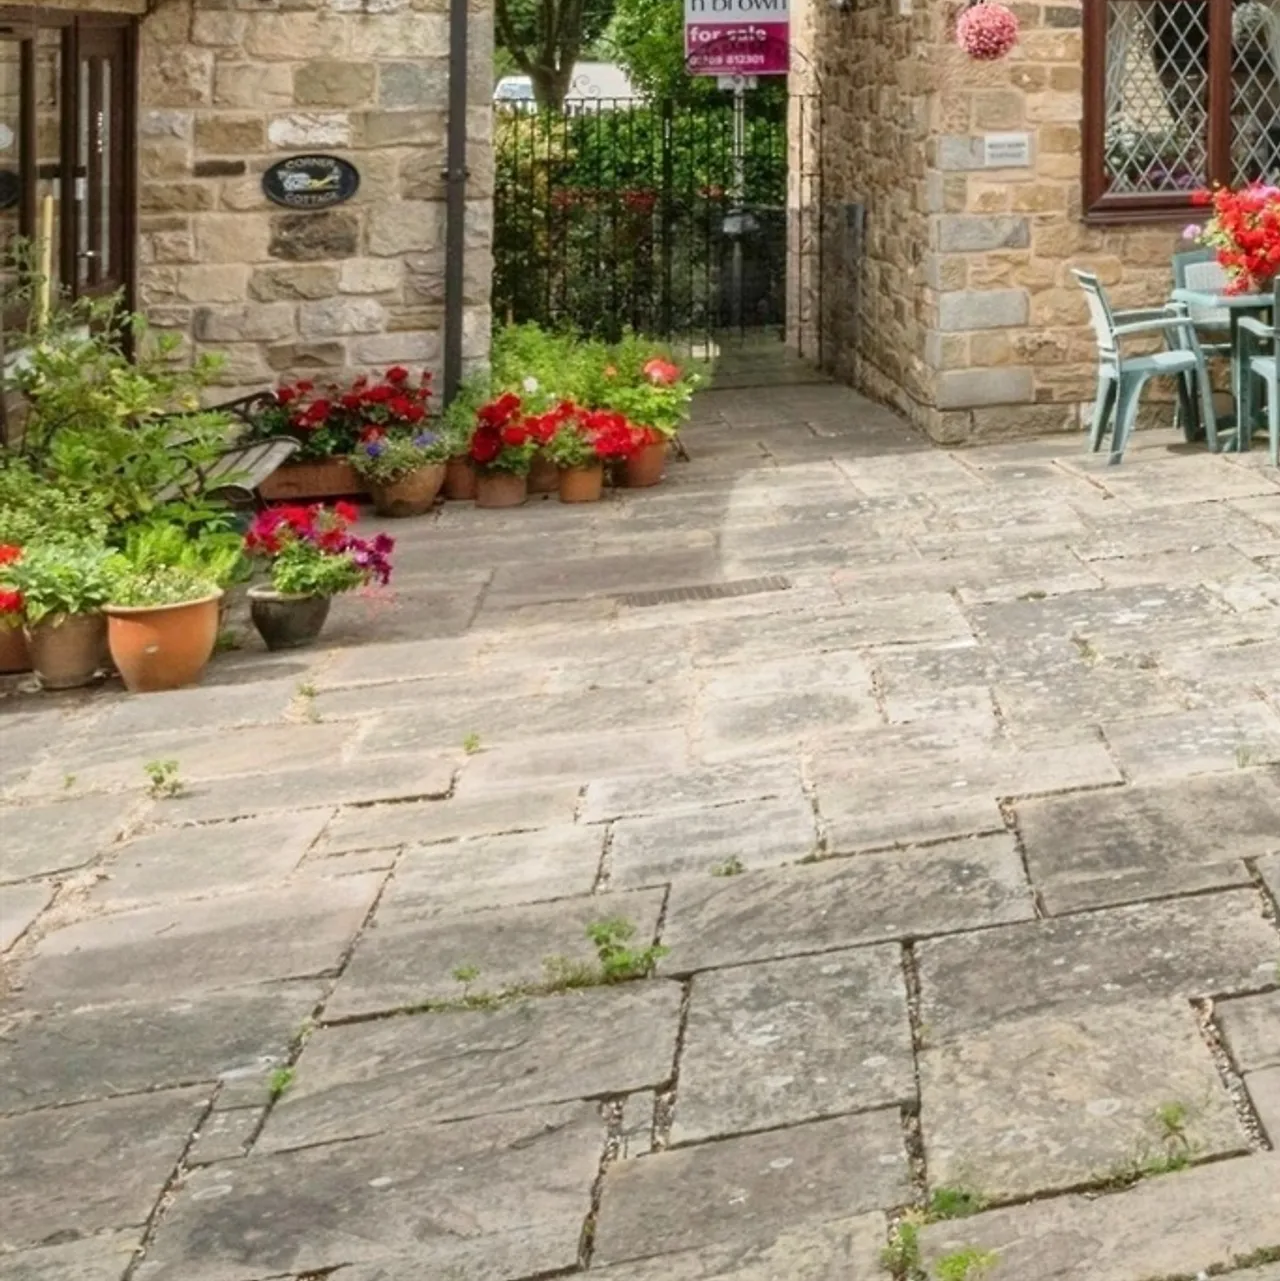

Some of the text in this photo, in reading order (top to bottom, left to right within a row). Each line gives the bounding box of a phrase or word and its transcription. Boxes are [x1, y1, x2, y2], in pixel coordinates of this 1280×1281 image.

[690, 25, 766, 42] for sale
[689, 54, 723, 66] 009
[285, 158, 336, 169] CORNER
